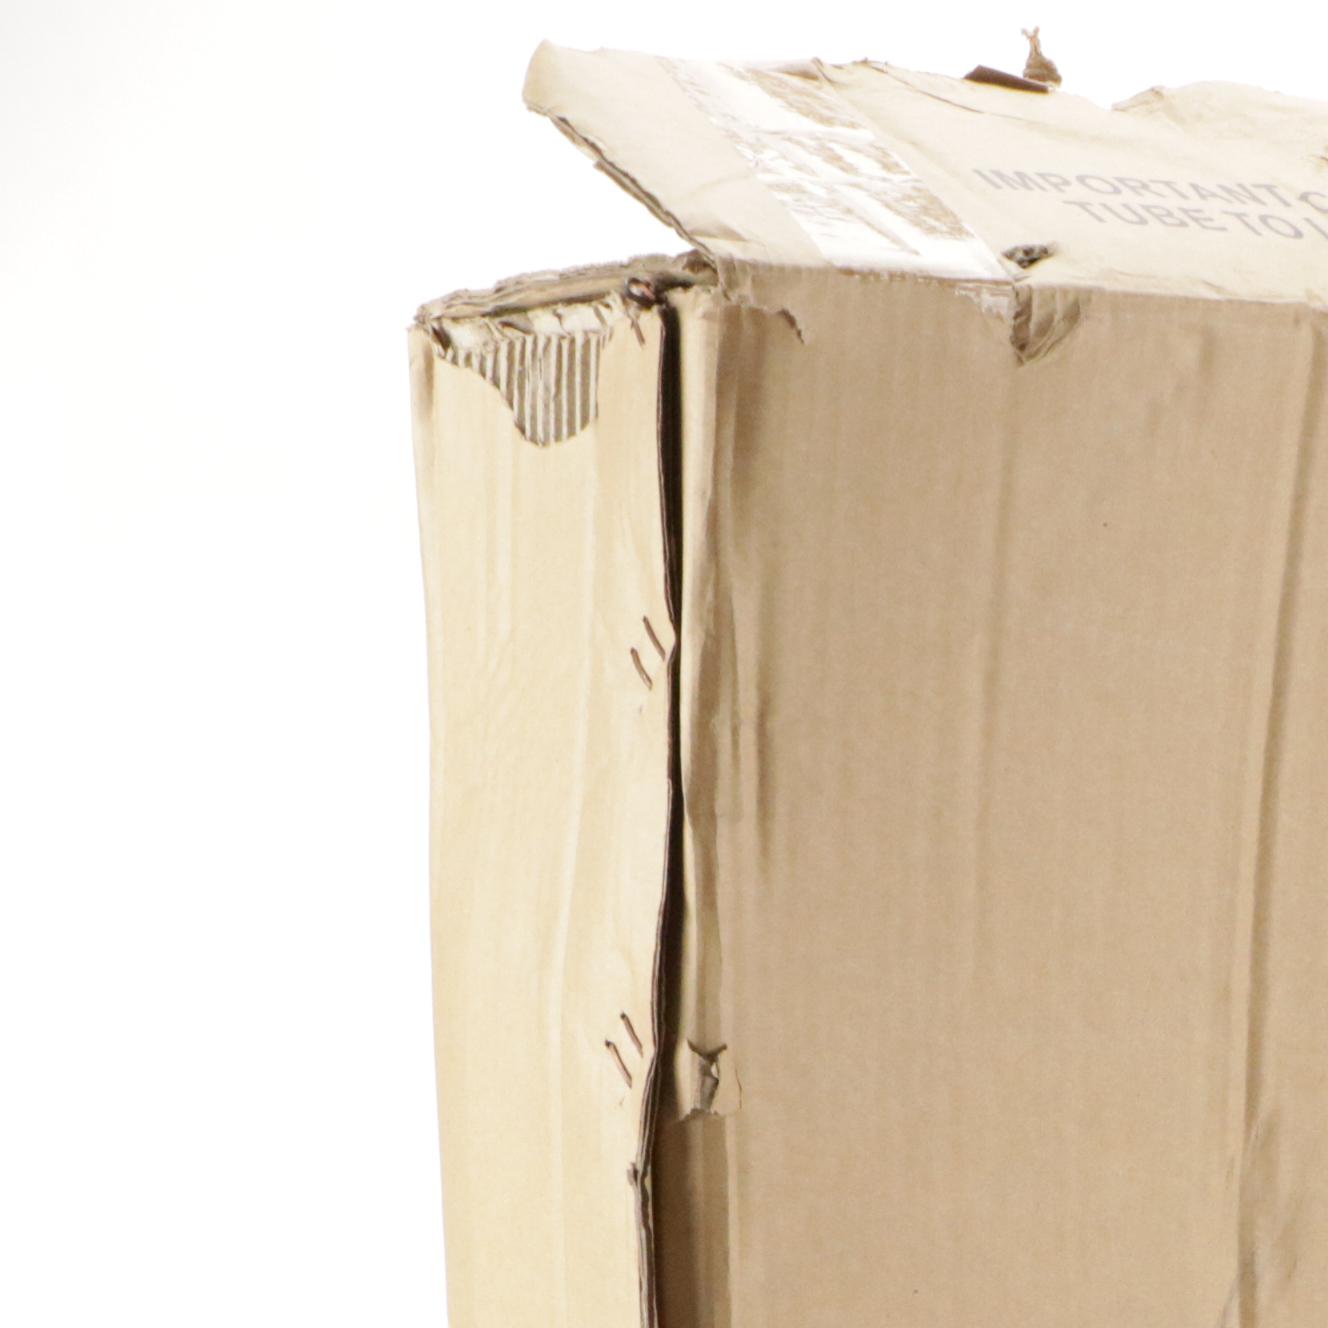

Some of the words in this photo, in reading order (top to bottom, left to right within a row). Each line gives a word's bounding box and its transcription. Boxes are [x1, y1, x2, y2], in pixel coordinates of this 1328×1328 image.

[972, 167, 1292, 208] IMPORTANT
[1062, 199, 1229, 232] TUBE
[1220, 209, 1304, 240] TO
